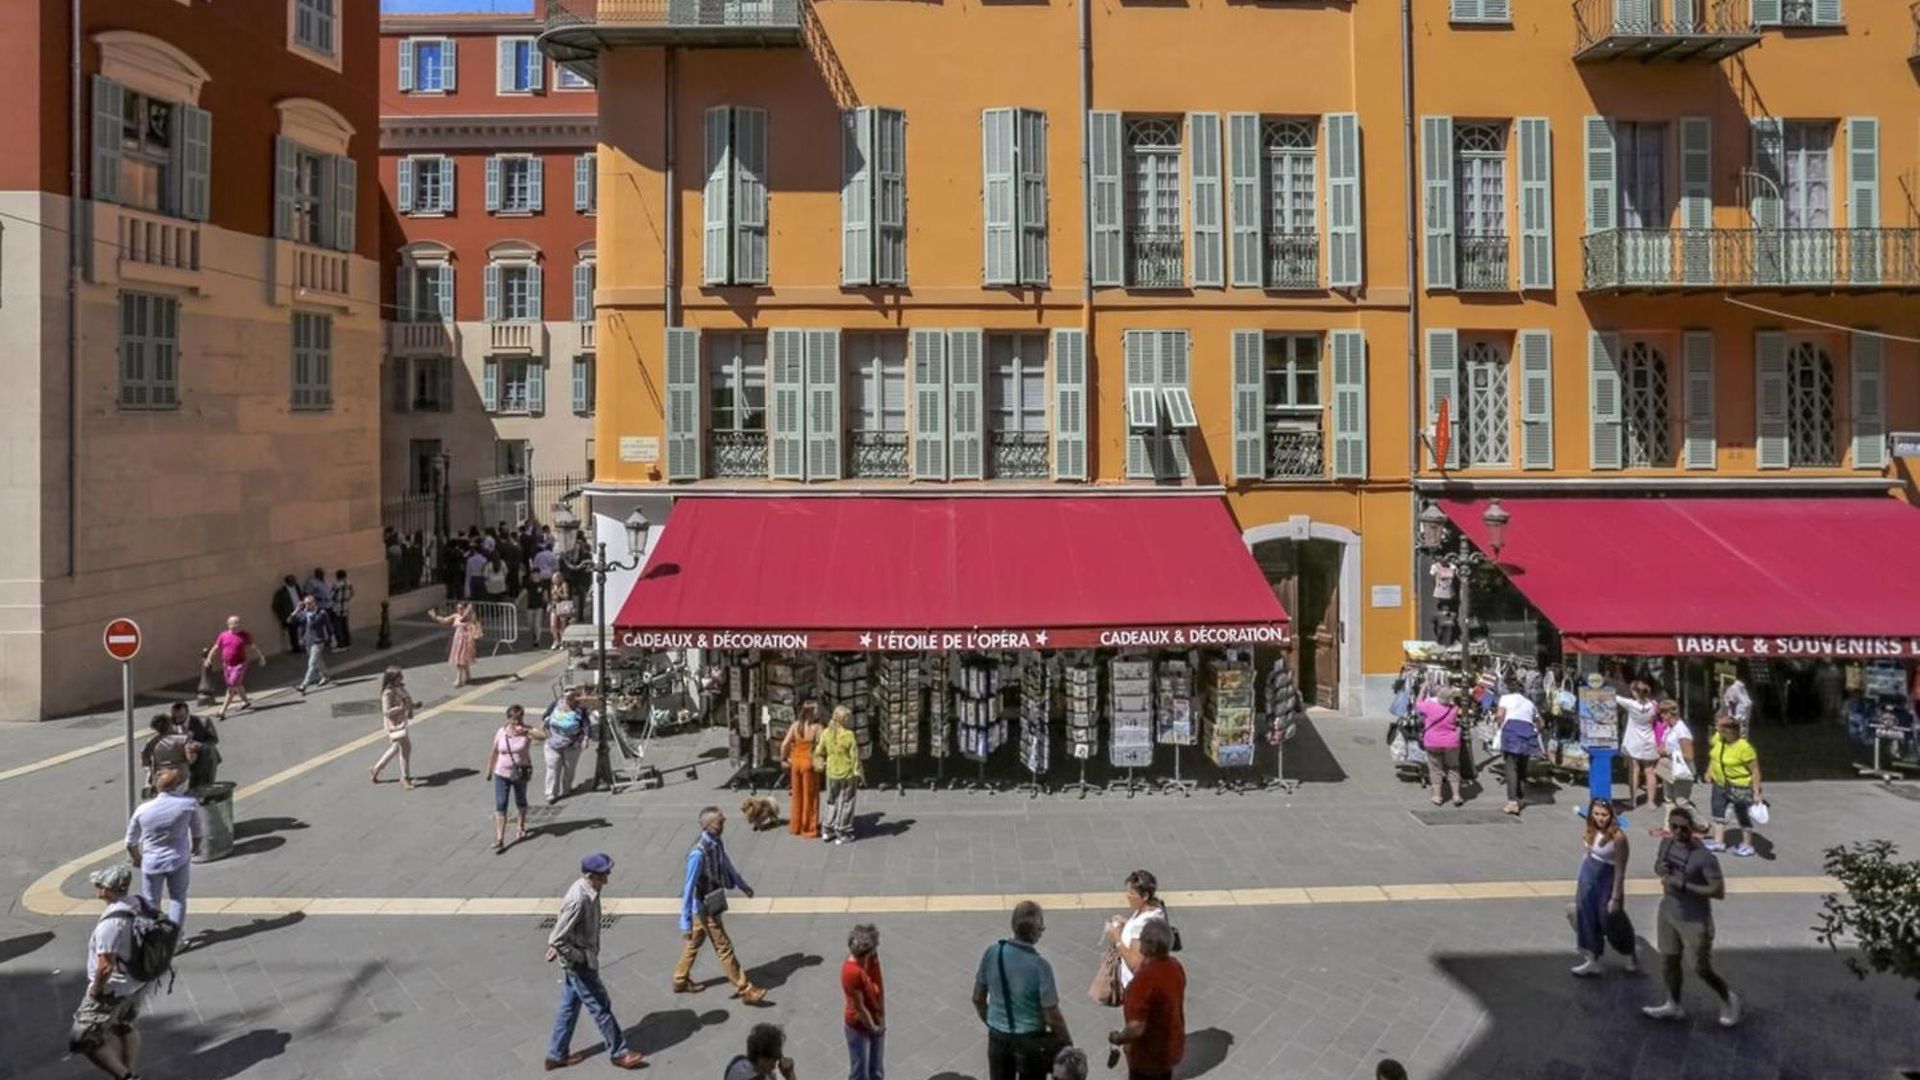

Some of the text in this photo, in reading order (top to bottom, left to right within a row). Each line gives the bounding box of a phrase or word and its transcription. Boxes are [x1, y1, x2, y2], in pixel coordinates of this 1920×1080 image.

[623, 631, 807, 648] CADEAUX & DÉCORATION
[943, 634, 962, 648] DE
[1100, 630, 1170, 645] CADEAUX
[1174, 630, 1185, 644] &
[1674, 635, 1745, 653] TABAC
[1753, 637, 1769, 654] &
[1776, 636, 1902, 655] SOUVENIRS
